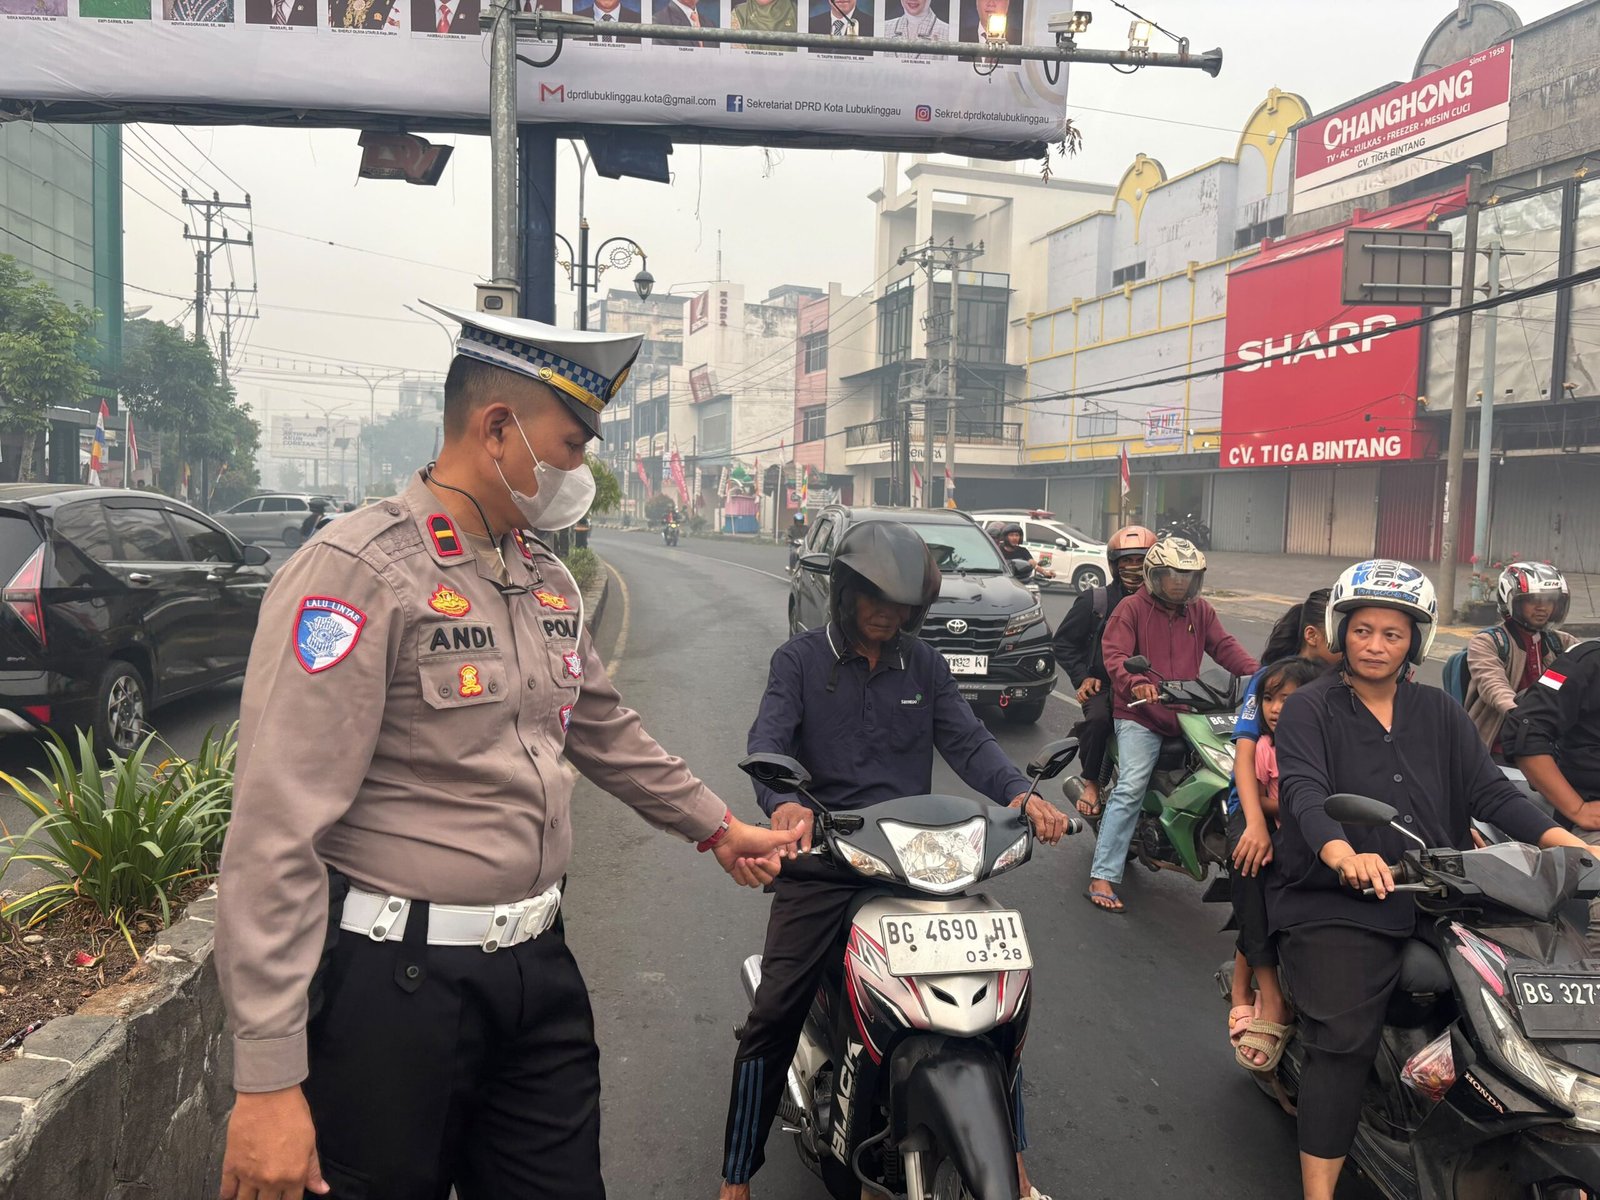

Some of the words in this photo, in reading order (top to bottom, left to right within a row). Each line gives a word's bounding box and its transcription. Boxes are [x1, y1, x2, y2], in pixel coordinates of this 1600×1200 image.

[1469, 54, 1487, 66] Since
[1489, 46, 1505, 58] 1958
[567, 90, 717, 107] dprdlubuklinggau.kota@gmail.com
[746, 98, 793, 110] Sekretariat
[795, 100, 822, 112] DPRD
[823, 102, 843, 113] Kota
[846, 103, 901, 117] Lubuklinggau
[935, 109, 1050, 125] Sekret.dprdkotalubuklinggau
[1326, 155, 1336, 164] TV
[1340, 148, 1350, 157] AC
[1354, 137, 1382, 154] KULKAS
[1386, 123, 1419, 141] FREEZER
[1424, 112, 1450, 127] MESIN
[1451, 103, 1471, 117] CUCI
[1357, 157, 1370, 169] CV.
[1371, 150, 1389, 166] TIGA
[1390, 137, 1426, 156] BINTANG
[1237, 314, 1397, 372] SHARP
[1229, 446, 1255, 465] CV.
[1261, 443, 1309, 463] TIGA
[1312, 435, 1401, 461] BINTANG
[1373, 579, 1403, 589] GM
[306, 599, 328, 608] LALU
[332, 602, 360, 621] LINTAS
[430, 626, 495, 652] ANDI
[1209, 716, 1225, 726] BG
[887, 921, 914, 945] BG
[925, 918, 978, 942] 4690
[992, 916, 1018, 941] HI
[1523, 982, 1553, 1004] BG
[831, 1036, 865, 1167] BLACK
[1464, 1070, 1505, 1114] HONDA
